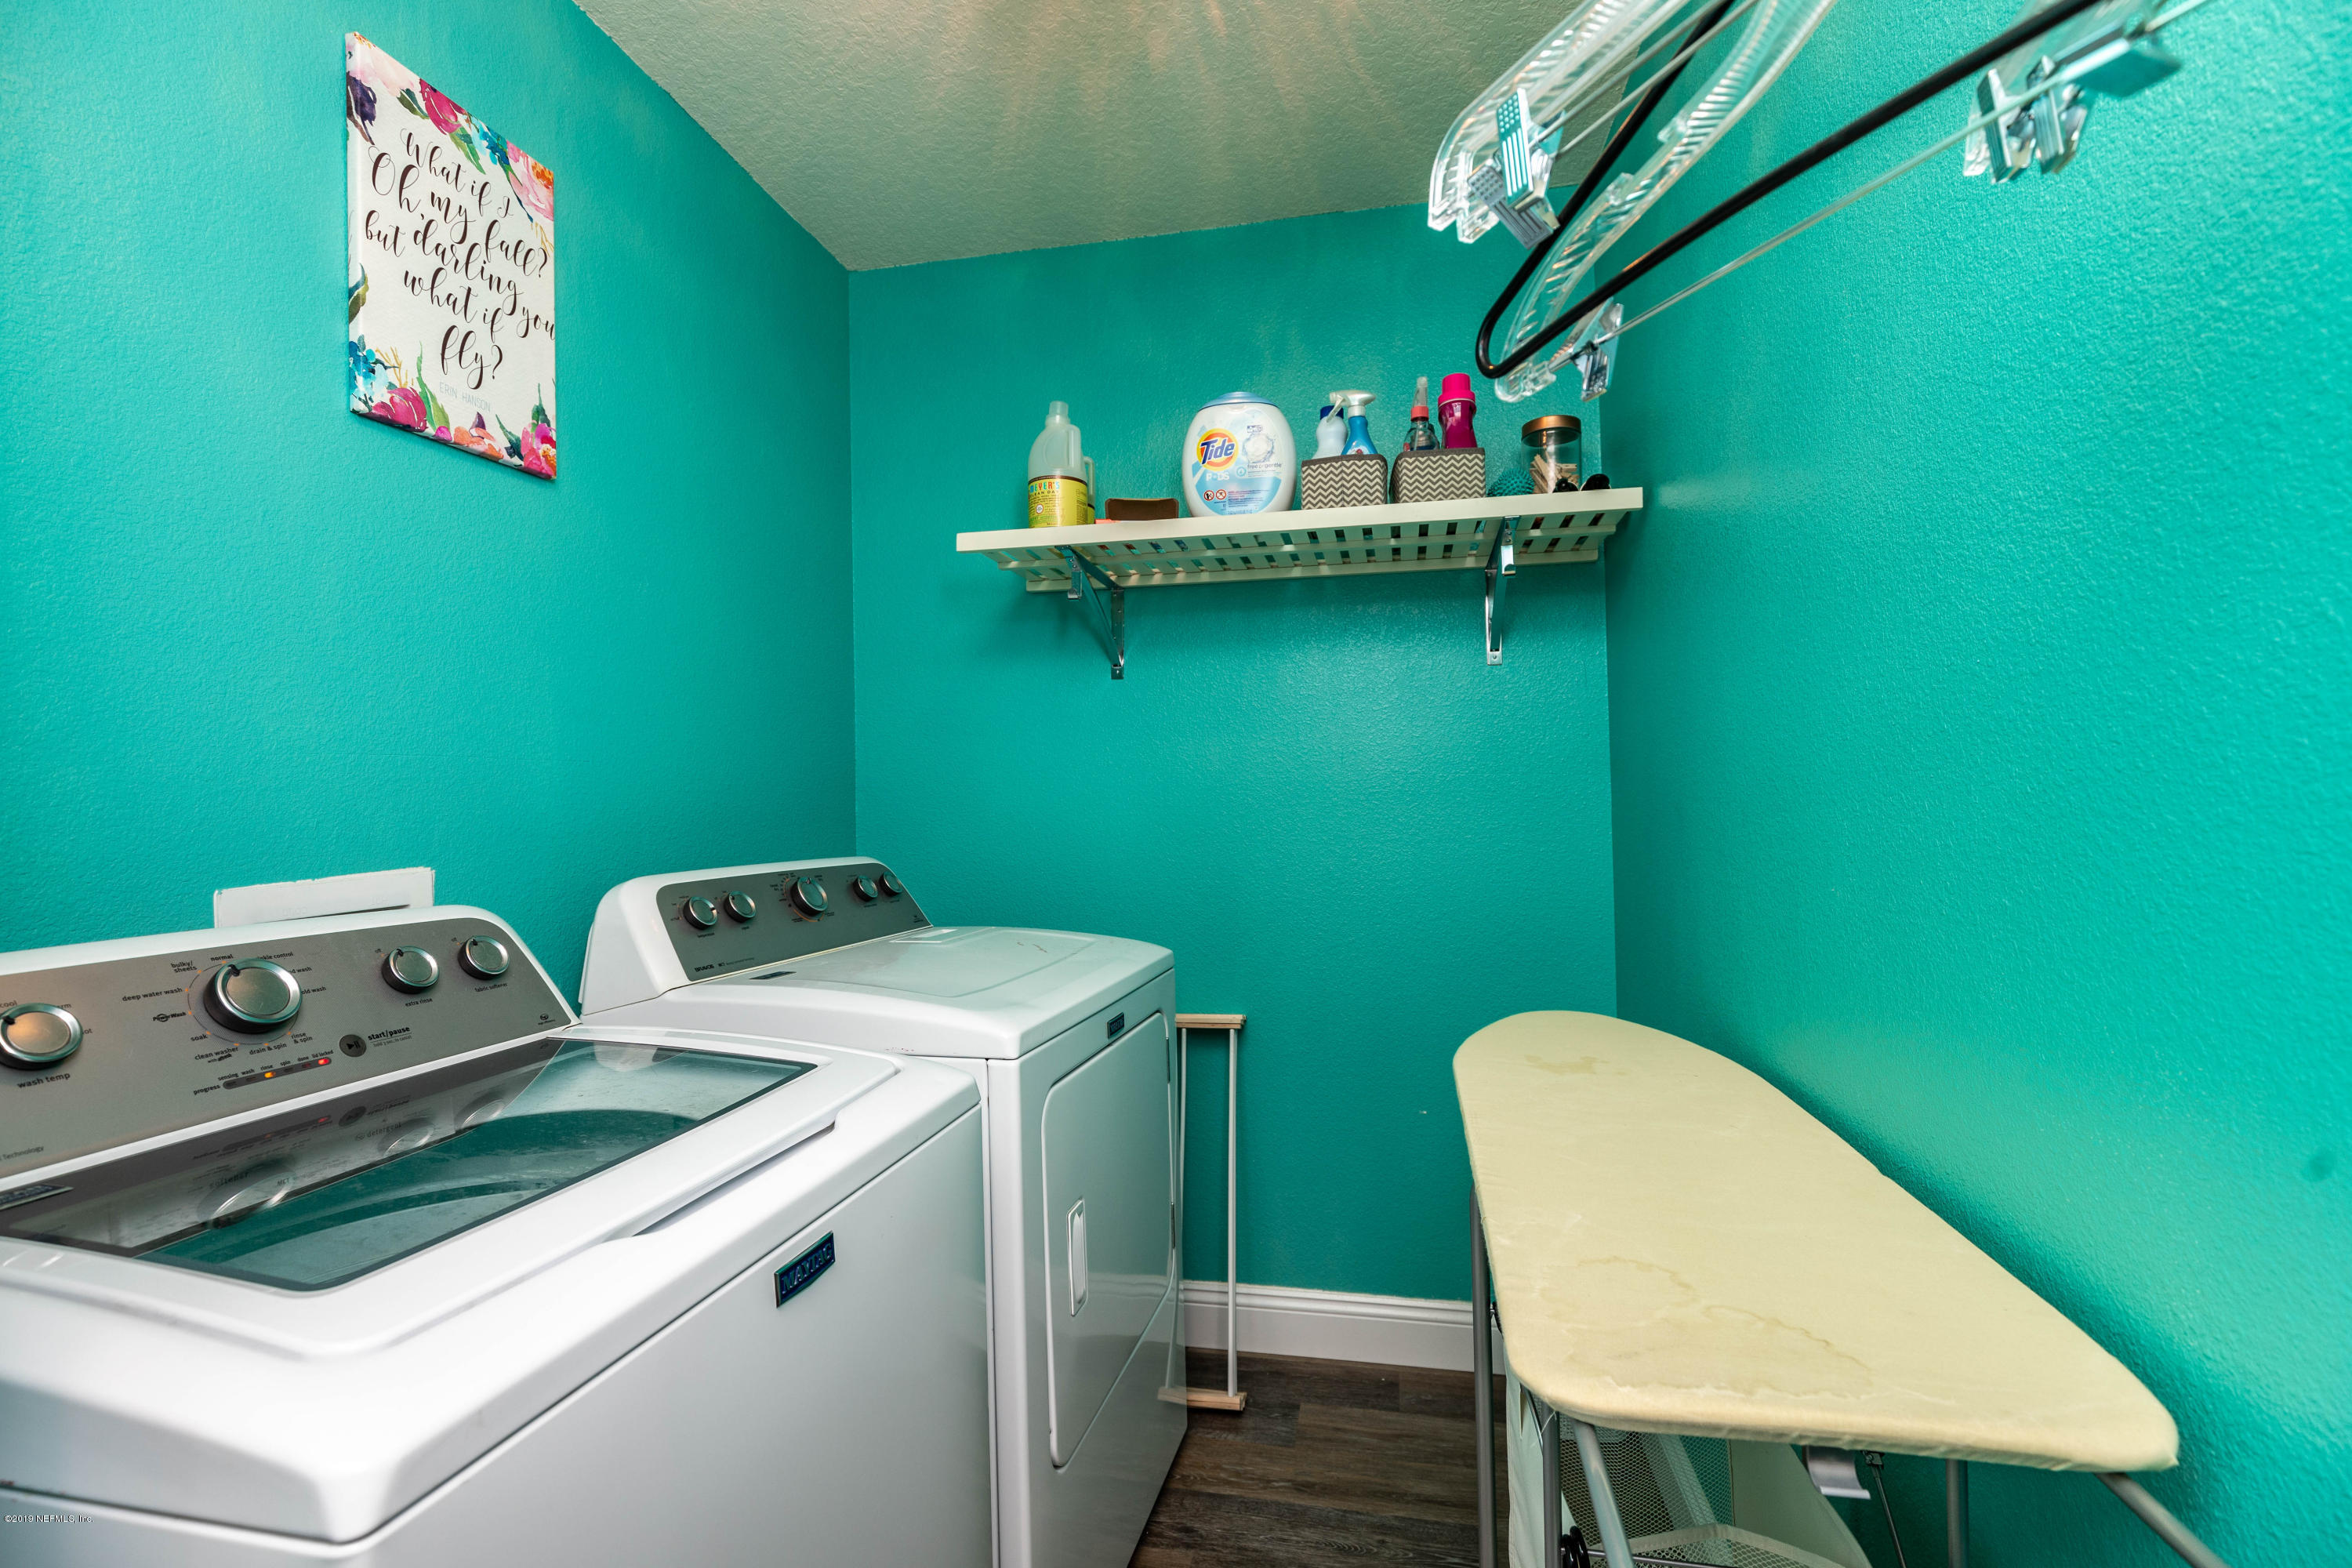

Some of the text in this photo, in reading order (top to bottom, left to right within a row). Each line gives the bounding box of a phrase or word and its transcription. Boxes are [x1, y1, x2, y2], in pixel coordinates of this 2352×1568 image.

[400, 129, 514, 218] What if I
[430, 191, 476, 245] my
[485, 220, 547, 278] fall?
[365, 210, 524, 315] but darling
[405, 267, 555, 343] what if you
[441, 325, 503, 390] fly?
[439, 382, 491, 412] ERIN HANSON
[1200, 437, 1235, 464] Tide
[122, 993, 141, 1002] deep
[153, 1011, 187, 1022] PowerWash
[368, 1027, 410, 1040] start/pause
[194, 1047, 238, 1061] clean washer
[249, 1047, 266, 1055] drain
[274, 1043, 287, 1051] spin
[17, 1073, 71, 1088] wash temp
[217, 1073, 239, 1081] sensing
[194, 1084, 221, 1095] progress
[781, 1243, 832, 1294] MAYTAG
